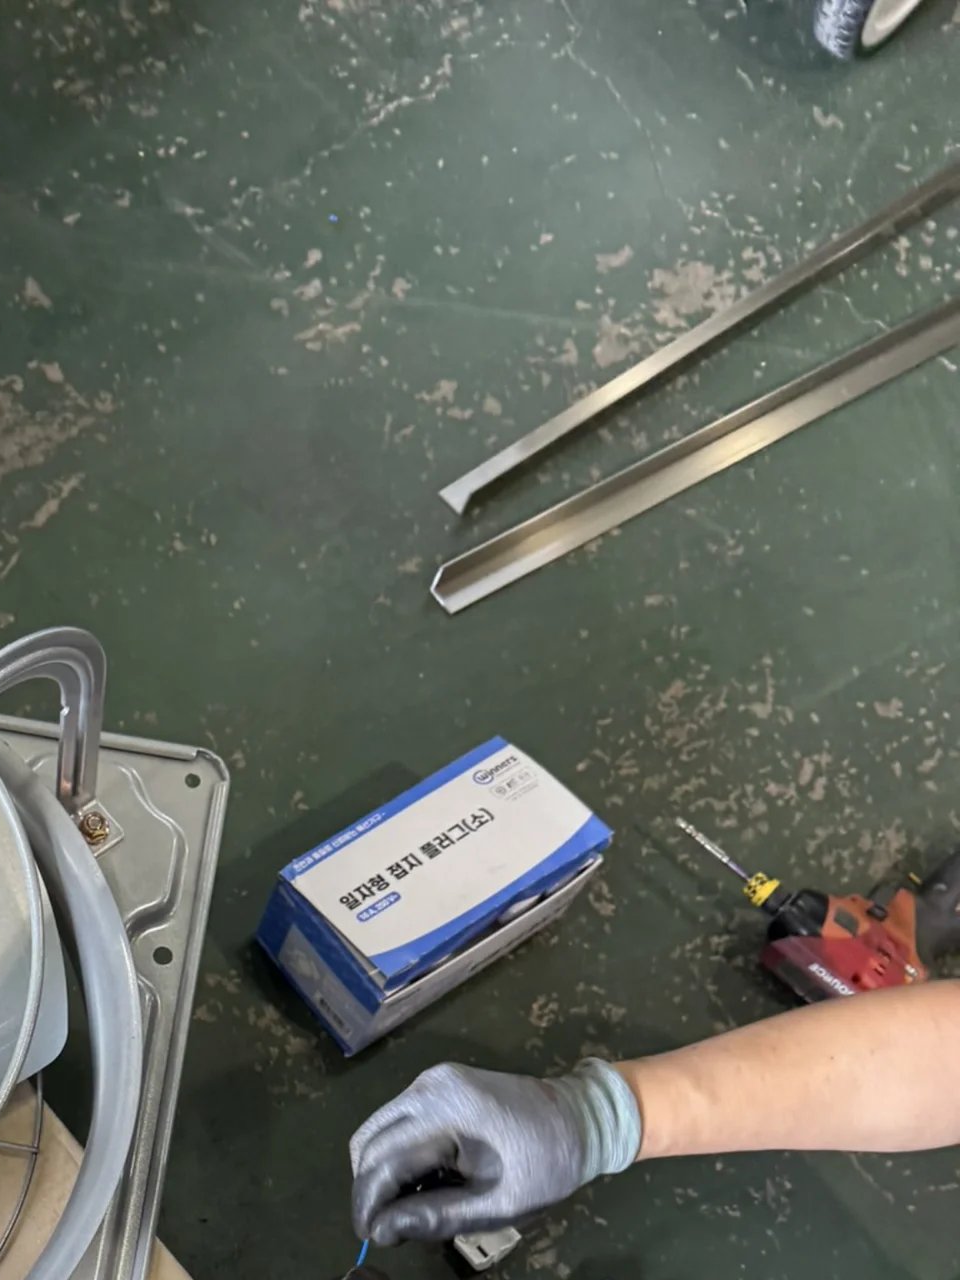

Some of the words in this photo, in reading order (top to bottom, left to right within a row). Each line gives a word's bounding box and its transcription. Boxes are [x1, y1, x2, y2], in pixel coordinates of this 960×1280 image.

[339, 874, 390, 911] 일자형
[386, 853, 423, 881] 접지
[418, 807, 495, 860] 플러그(소)
